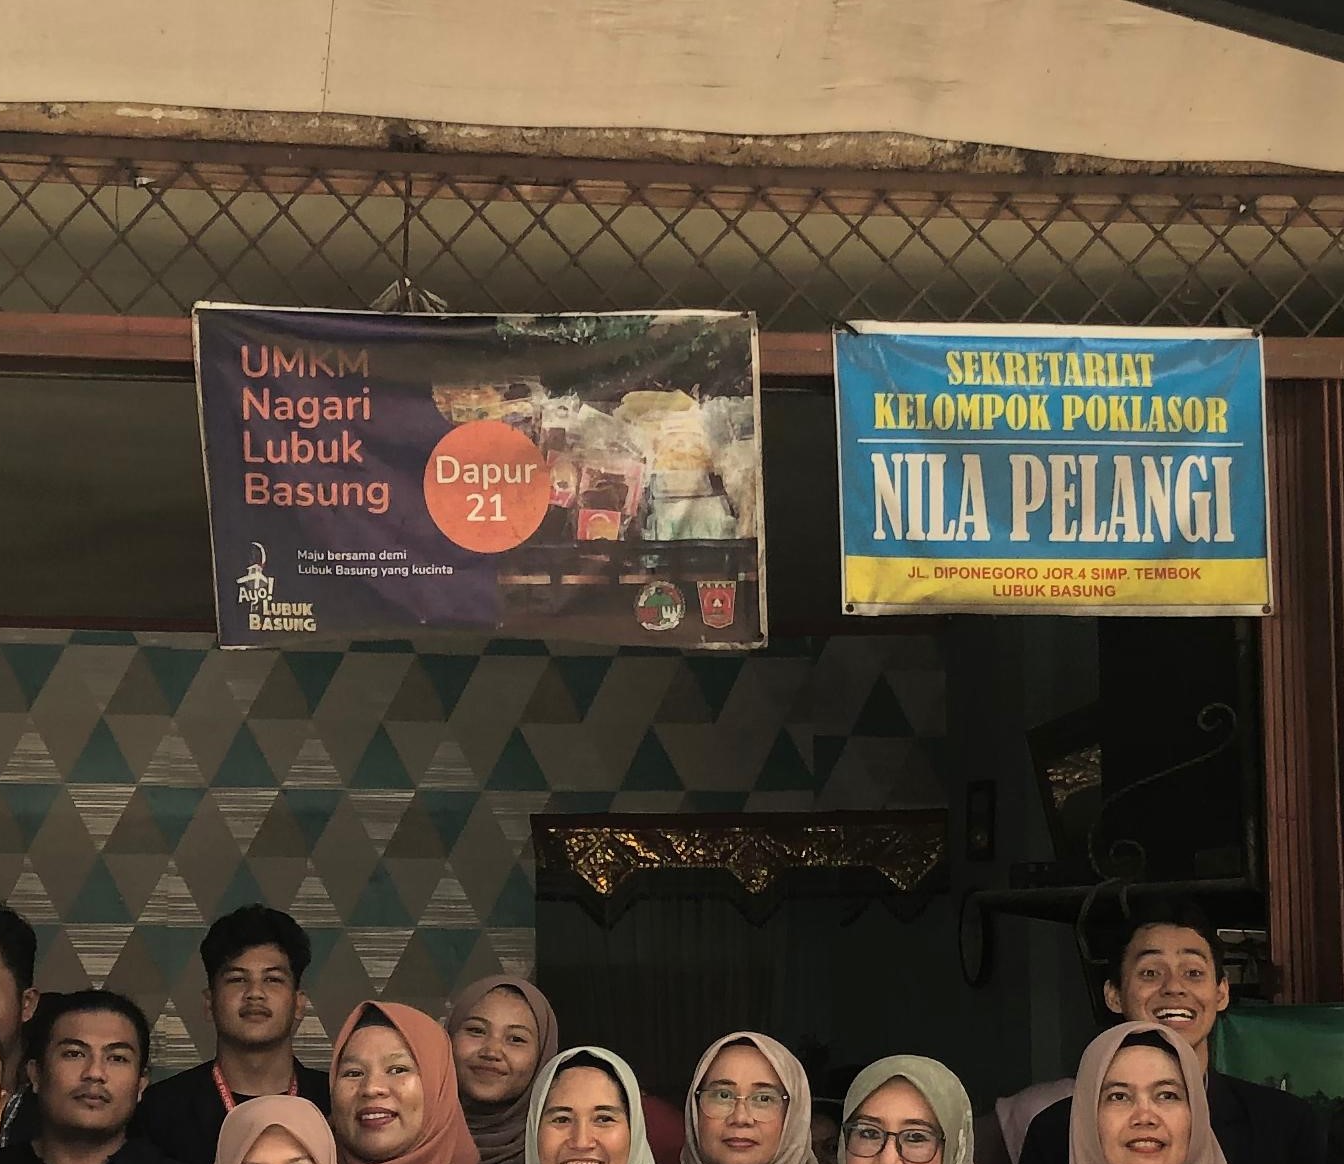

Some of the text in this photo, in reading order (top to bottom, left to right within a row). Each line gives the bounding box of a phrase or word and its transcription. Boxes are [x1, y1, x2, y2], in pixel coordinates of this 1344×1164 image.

[240, 344, 369, 378] UMKM
[946, 351, 1154, 388] SEKRETARIAT
[242, 388, 371, 429] Nagari
[874, 392, 1228, 434] KELOMPOK POKLASOR
[243, 431, 363, 464] Lubuk
[436, 455, 537, 491] Dapur
[244, 472, 390, 514] Basung
[466, 494, 507, 522] 21
[871, 452, 1235, 542] NILA PELANGI
[297, 550, 407, 562] Maju bersama demi
[298, 564, 453, 577] Lubuk Basung yang kucinta
[908, 566, 929, 580] JL.
[934, 567, 1039, 580] DIPONEGORO
[1091, 567, 1130, 580] SIMP.
[1137, 567, 1201, 580] TEMBOK
[238, 577, 275, 604] Ayo!
[992, 585, 1116, 598] LUBUK BASUNG
[249, 614, 317, 632] BASUNG
[262, 600, 313, 616] LUBUK
